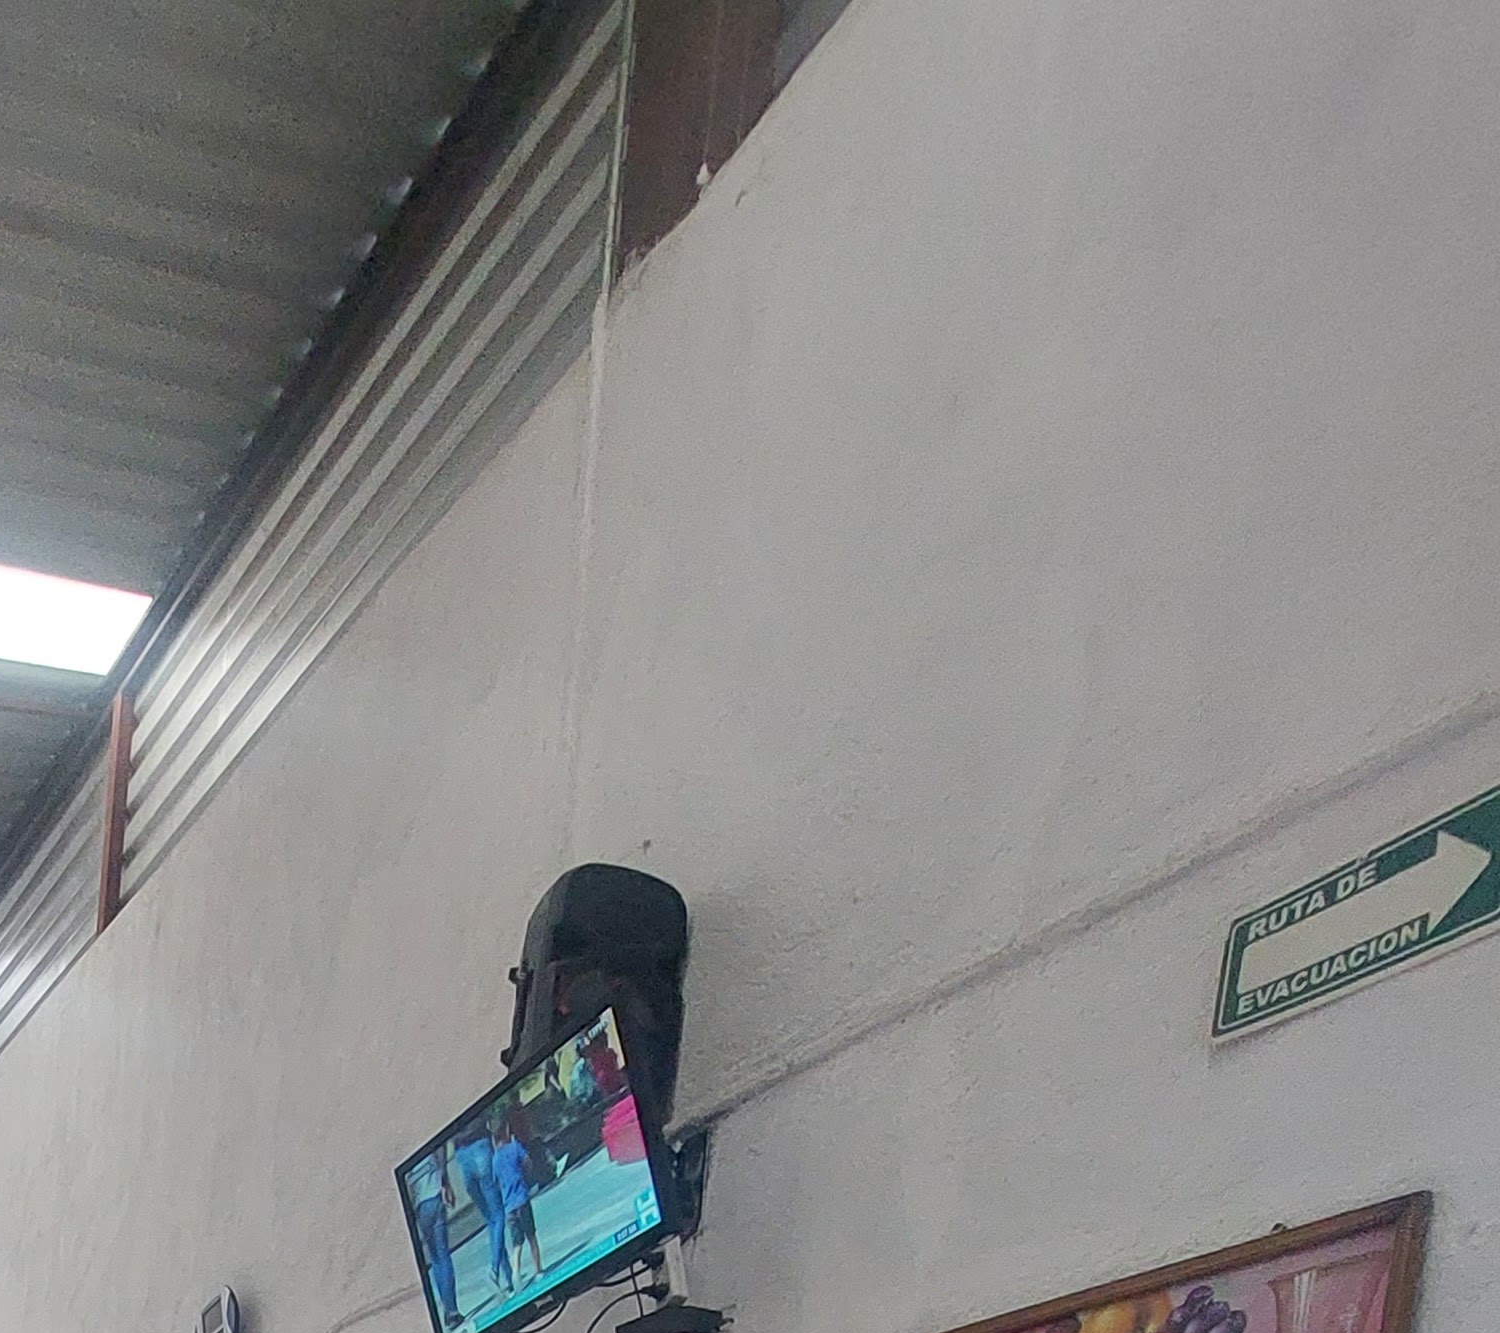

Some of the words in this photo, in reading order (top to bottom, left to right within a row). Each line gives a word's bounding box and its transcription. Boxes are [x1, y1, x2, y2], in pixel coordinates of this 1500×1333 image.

[1248, 889, 1327, 941] RUTA
[1335, 860, 1379, 901] DE
[1236, 919, 1422, 1016] EVACUACION
